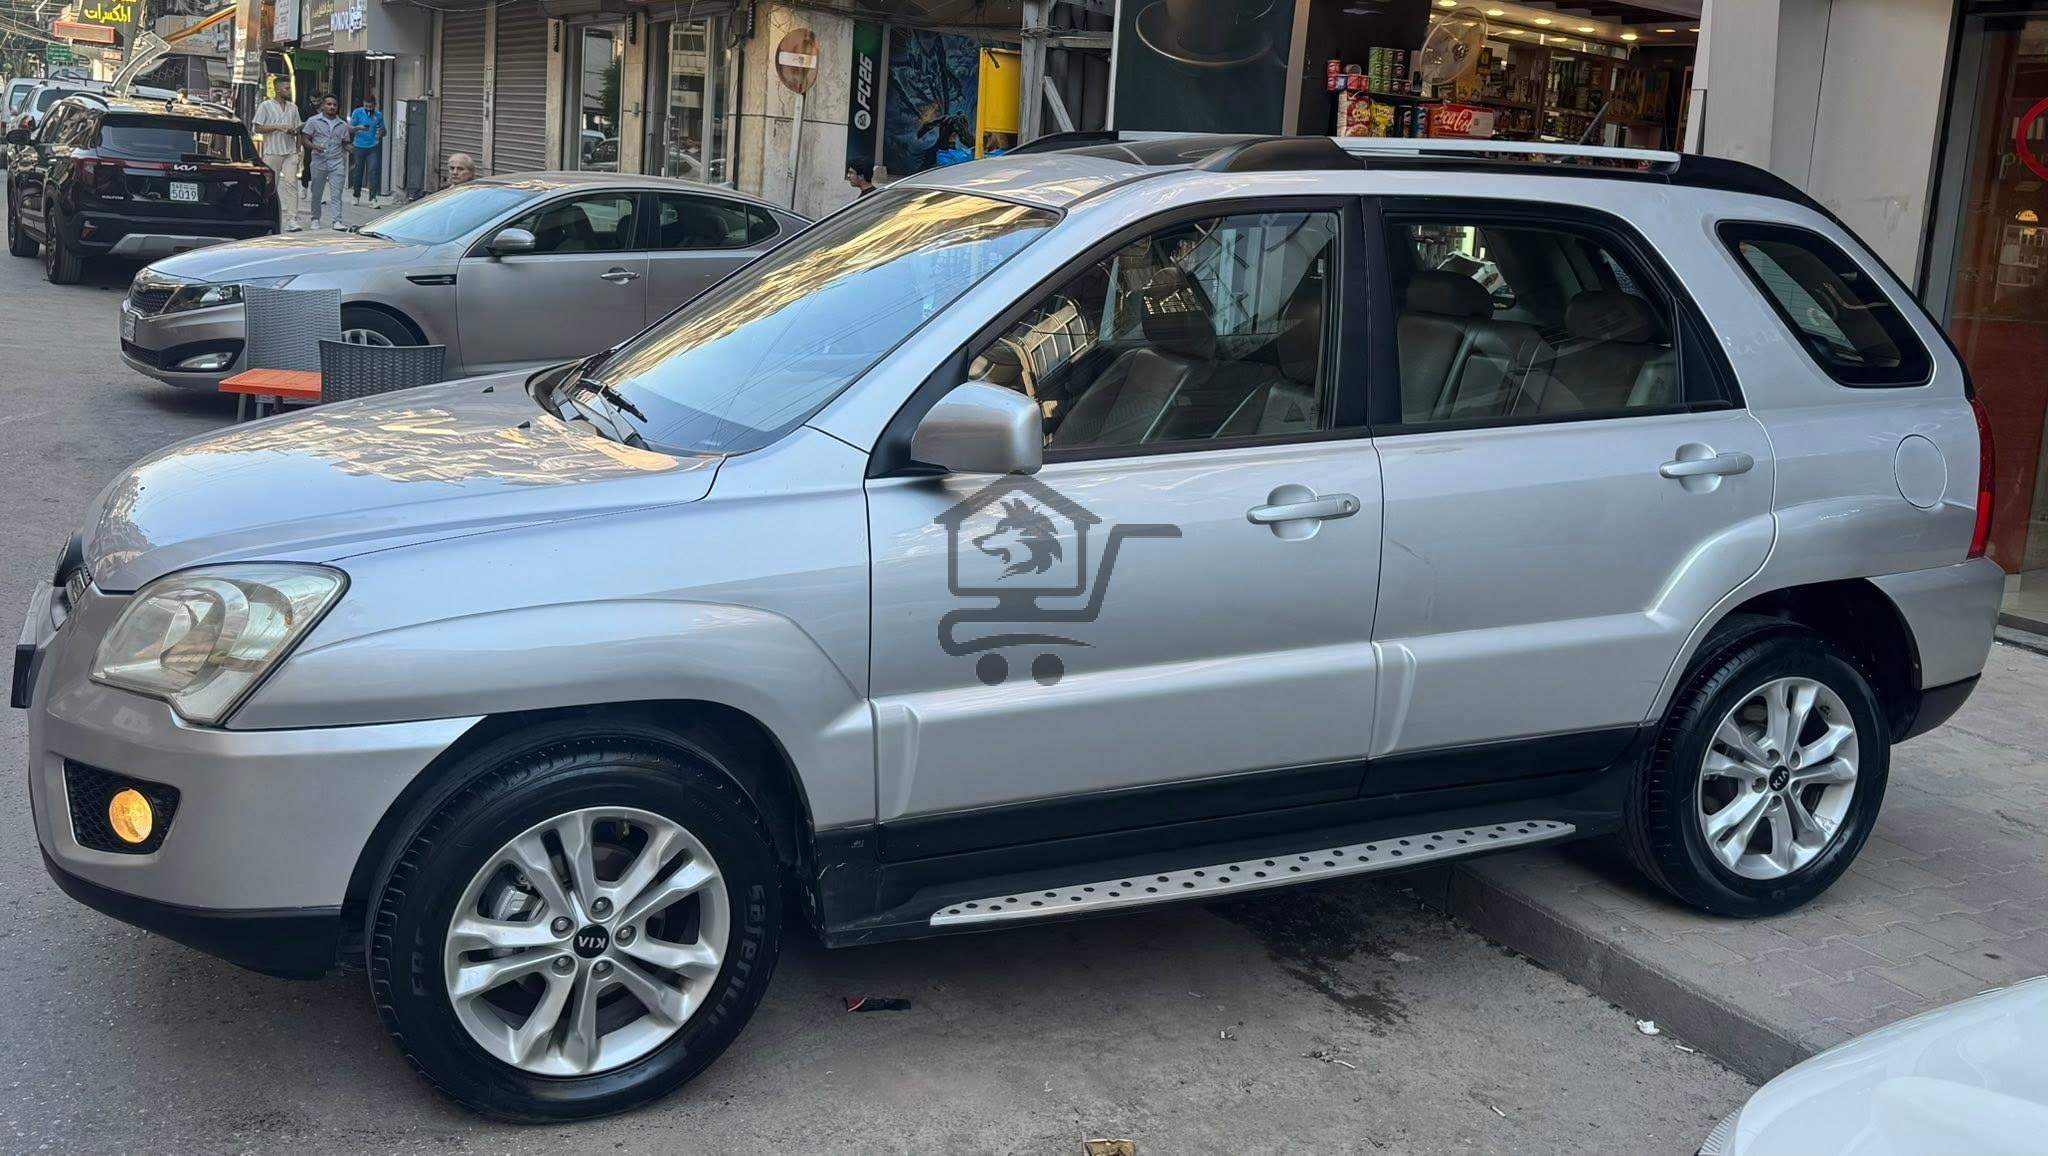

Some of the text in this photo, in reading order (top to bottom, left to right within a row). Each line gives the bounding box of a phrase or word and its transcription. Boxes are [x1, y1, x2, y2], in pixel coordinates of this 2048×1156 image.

[84, 3, 131, 24] المكسرات
[857, 52, 872, 111] FC26
[1773, 770, 1788, 789] KIA
[578, 935, 606, 949] KIA
